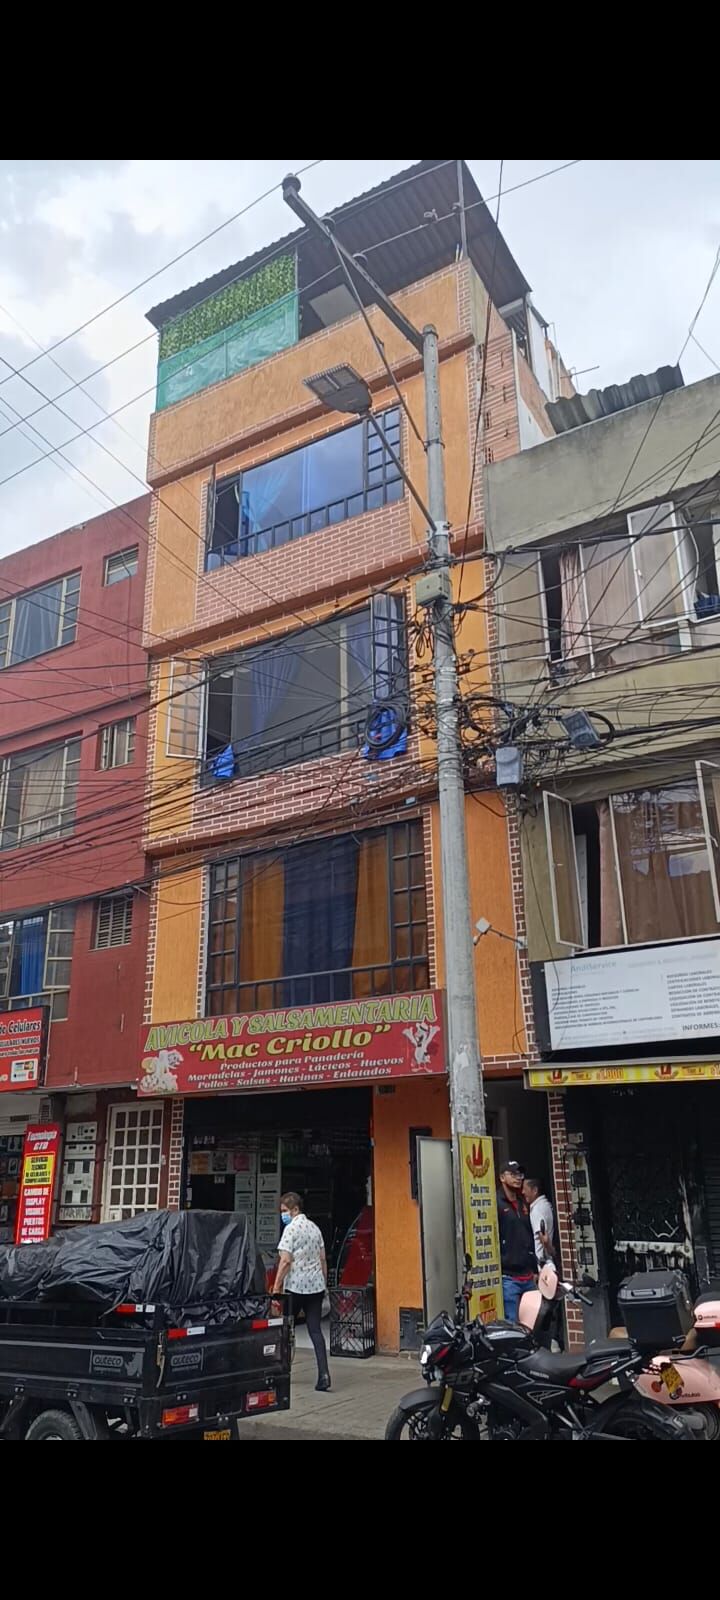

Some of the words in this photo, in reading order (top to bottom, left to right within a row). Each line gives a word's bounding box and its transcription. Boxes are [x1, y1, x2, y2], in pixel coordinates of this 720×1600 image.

[8, 1019, 41, 1035] Celulares
[144, 1017, 229, 1052] AVICOLA
[231, 1014, 249, 1037] Y
[247, 993, 438, 1035] SALSAMENTARIA
[188, 1070, 245, 1082] Mortadelas
[253, 1066, 299, 1078] Jamones
[308, 1062, 350, 1073] Lácteos
[360, 1056, 404, 1067] Huevos
[220, 1059, 273, 1071] Productos
[274, 1057, 301, 1068] para
[198, 1079, 228, 1089] Pollos
[236, 1076, 270, 1087] Salsas
[279, 1072, 324, 1083] Harinas
[333, 1067, 392, 1079] Enlatados
[25, 1197, 45, 1206] DISPLAY
[28, 1227, 44, 1235] CARGA
[94, 1356, 122, 1366] auteco
[172, 1354, 199, 1365] auteco
